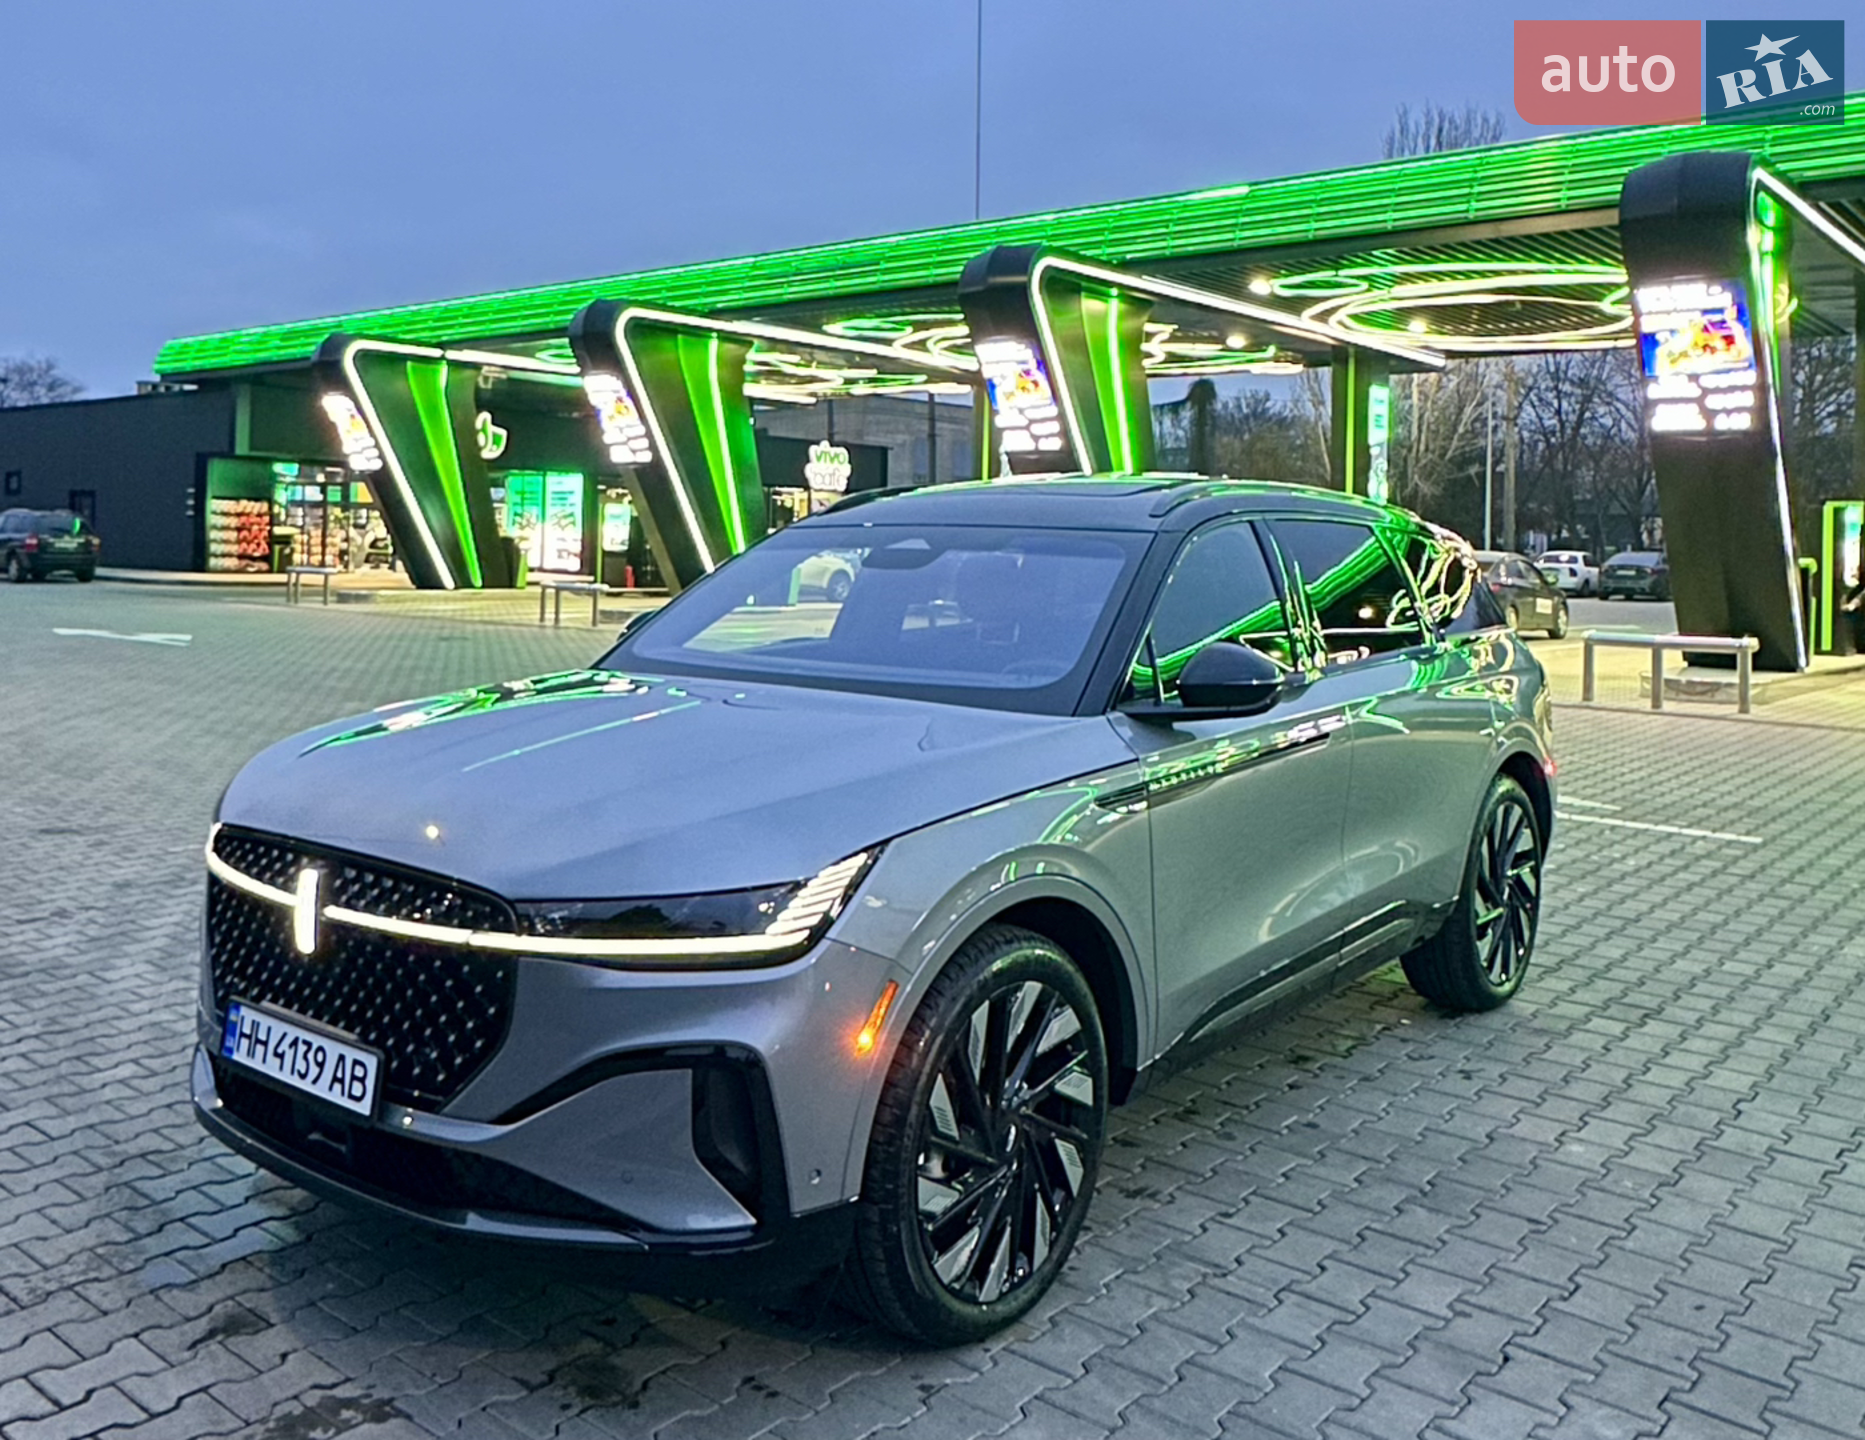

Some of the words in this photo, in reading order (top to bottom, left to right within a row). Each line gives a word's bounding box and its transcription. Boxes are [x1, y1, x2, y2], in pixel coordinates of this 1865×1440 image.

[236, 1014, 272, 1065] HH
[272, 1031, 327, 1086] 4139
[328, 1053, 368, 1103] AB
